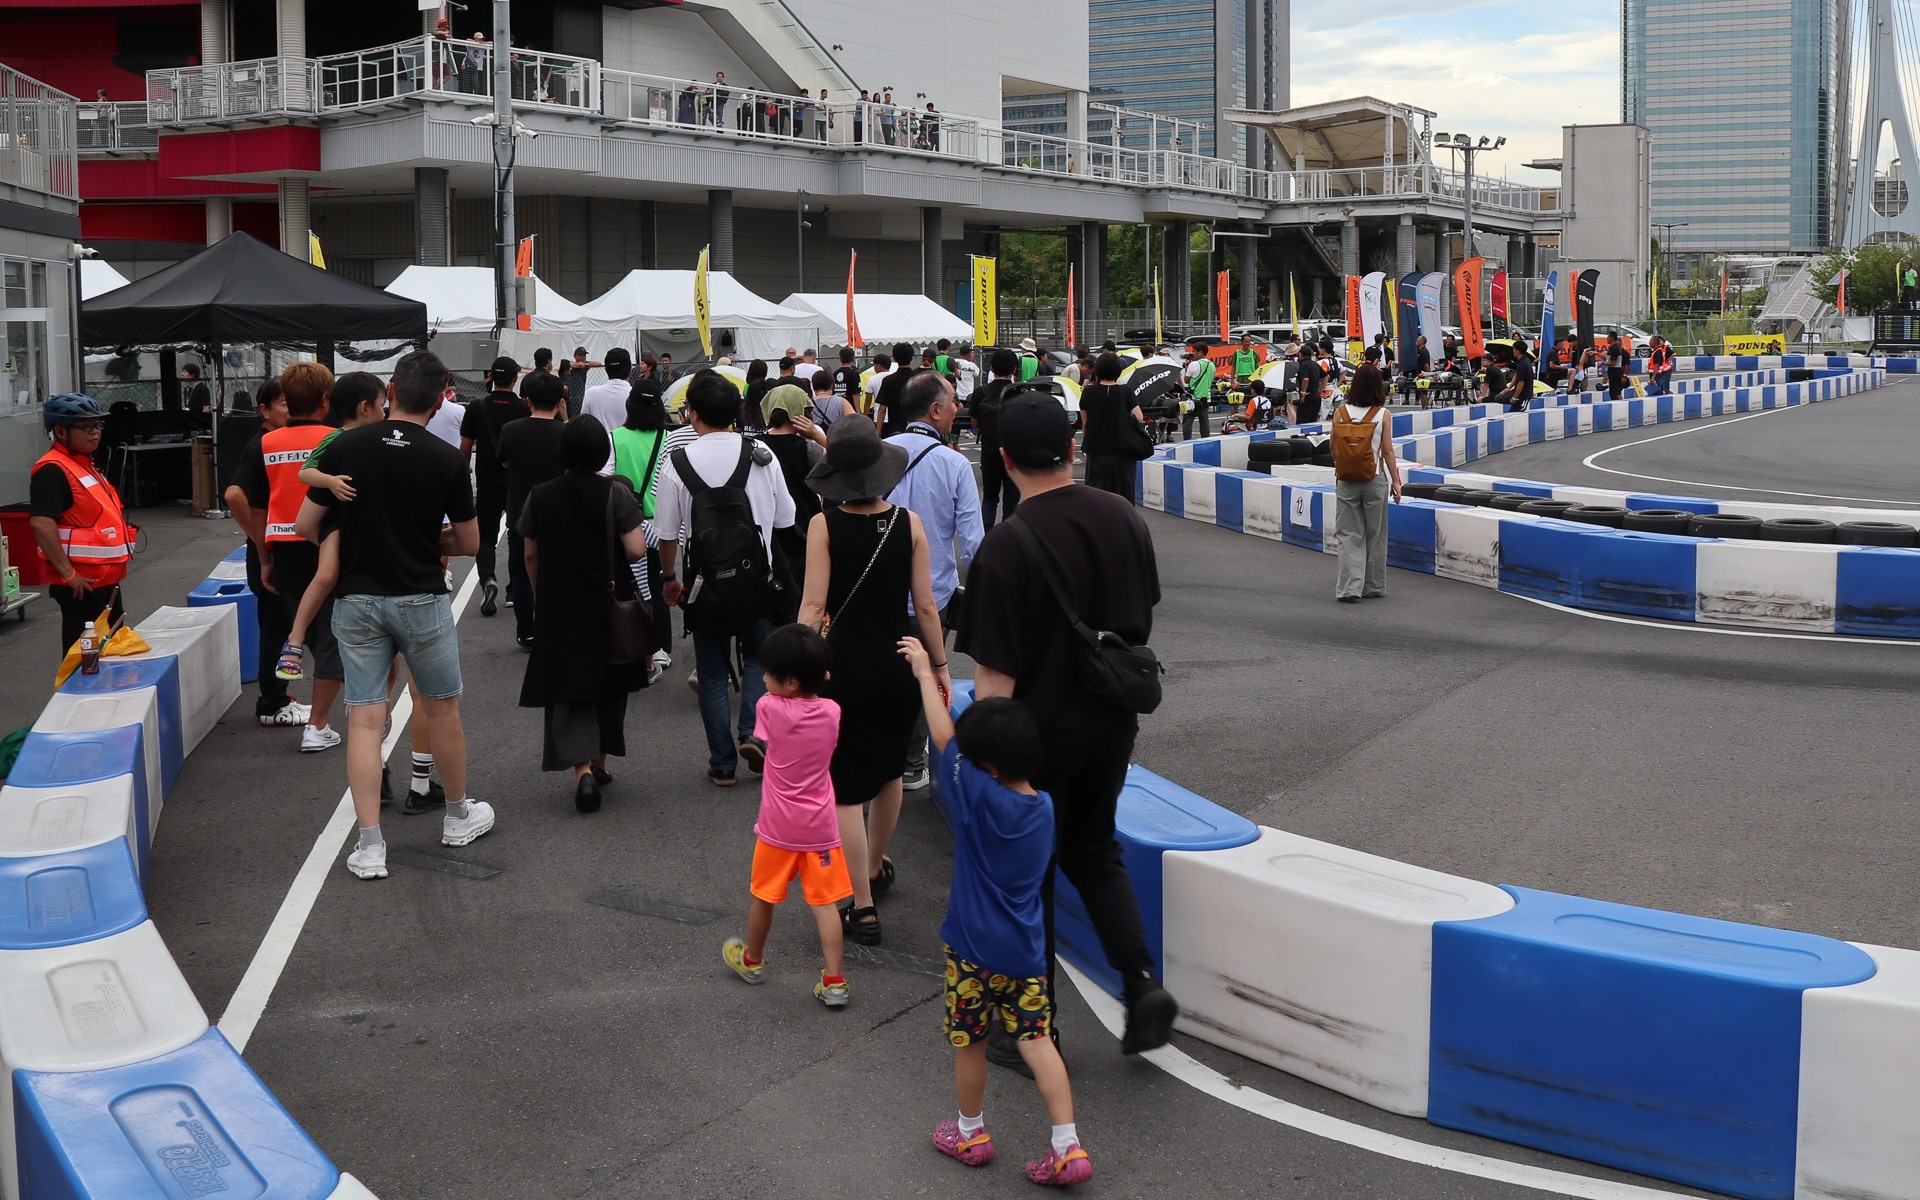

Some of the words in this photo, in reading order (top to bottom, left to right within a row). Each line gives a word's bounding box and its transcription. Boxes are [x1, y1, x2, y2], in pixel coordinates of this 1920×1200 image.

[981, 276, 989, 341] DUNLOP
[1737, 342, 1767, 351] DUNL
[1210, 355, 1232, 368] AUTO
[1238, 356, 1253, 364] PRESS
[1133, 370, 1171, 396] DUNLOP
[1232, 393, 1240, 401] 14
[912, 427, 929, 435] Canon
[269, 452, 309, 463] OFFIC
[158, 1143, 230, 1199] TECPRO
